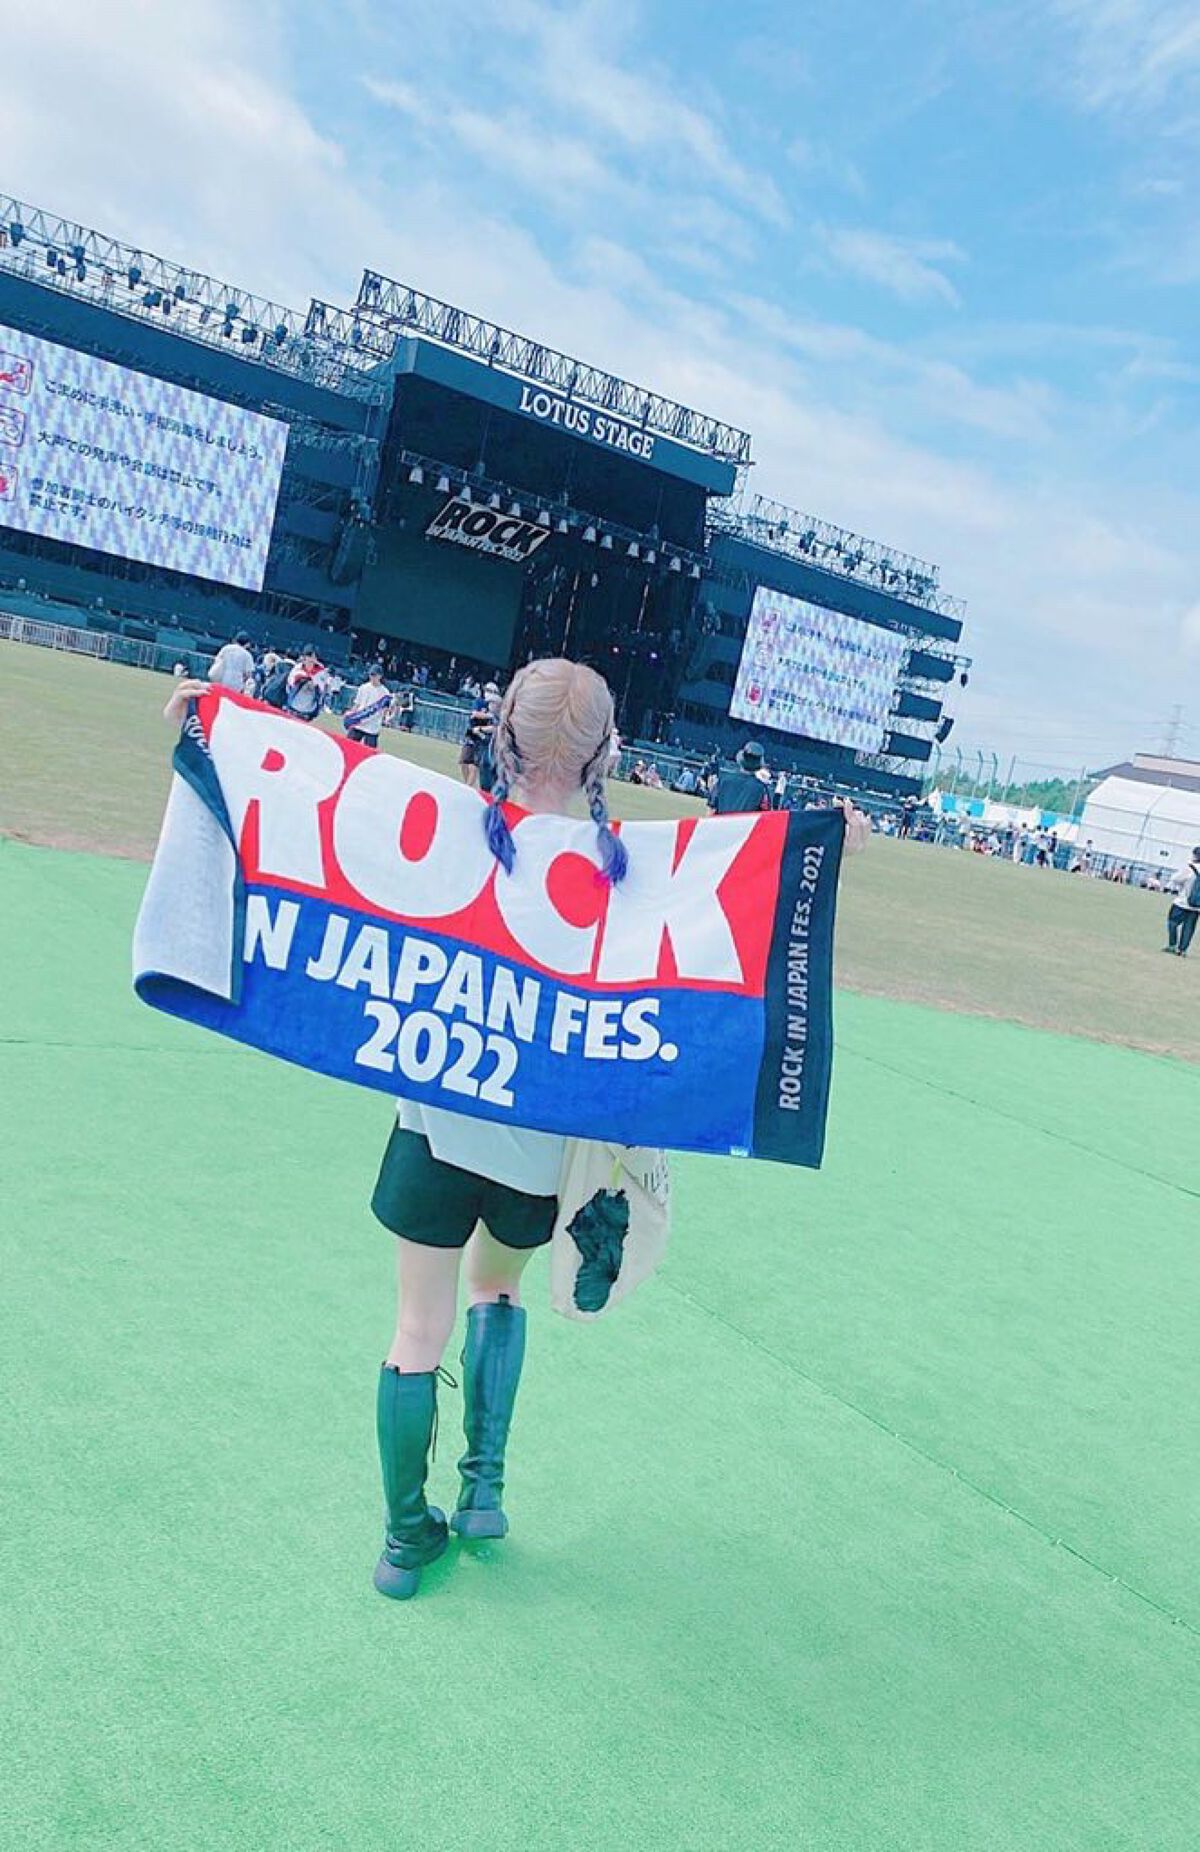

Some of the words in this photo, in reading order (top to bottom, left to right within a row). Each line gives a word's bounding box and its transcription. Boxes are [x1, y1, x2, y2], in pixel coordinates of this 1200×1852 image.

[519, 386, 590, 434] LOTUS
[593, 417, 654, 460] STAGE
[434, 501, 547, 553] ROCK
[210, 696, 759, 984] ROCK
[800, 845, 824, 892] 2022
[791, 897, 812, 937] FES.
[306, 916, 539, 1042] JAPAN
[550, 990, 680, 1063] FES.
[787, 943, 808, 1010] JAPAN
[354, 1000, 518, 1107] 2022
[787, 1014, 806, 1041] IN
[780, 1046, 804, 1110] ROCK
